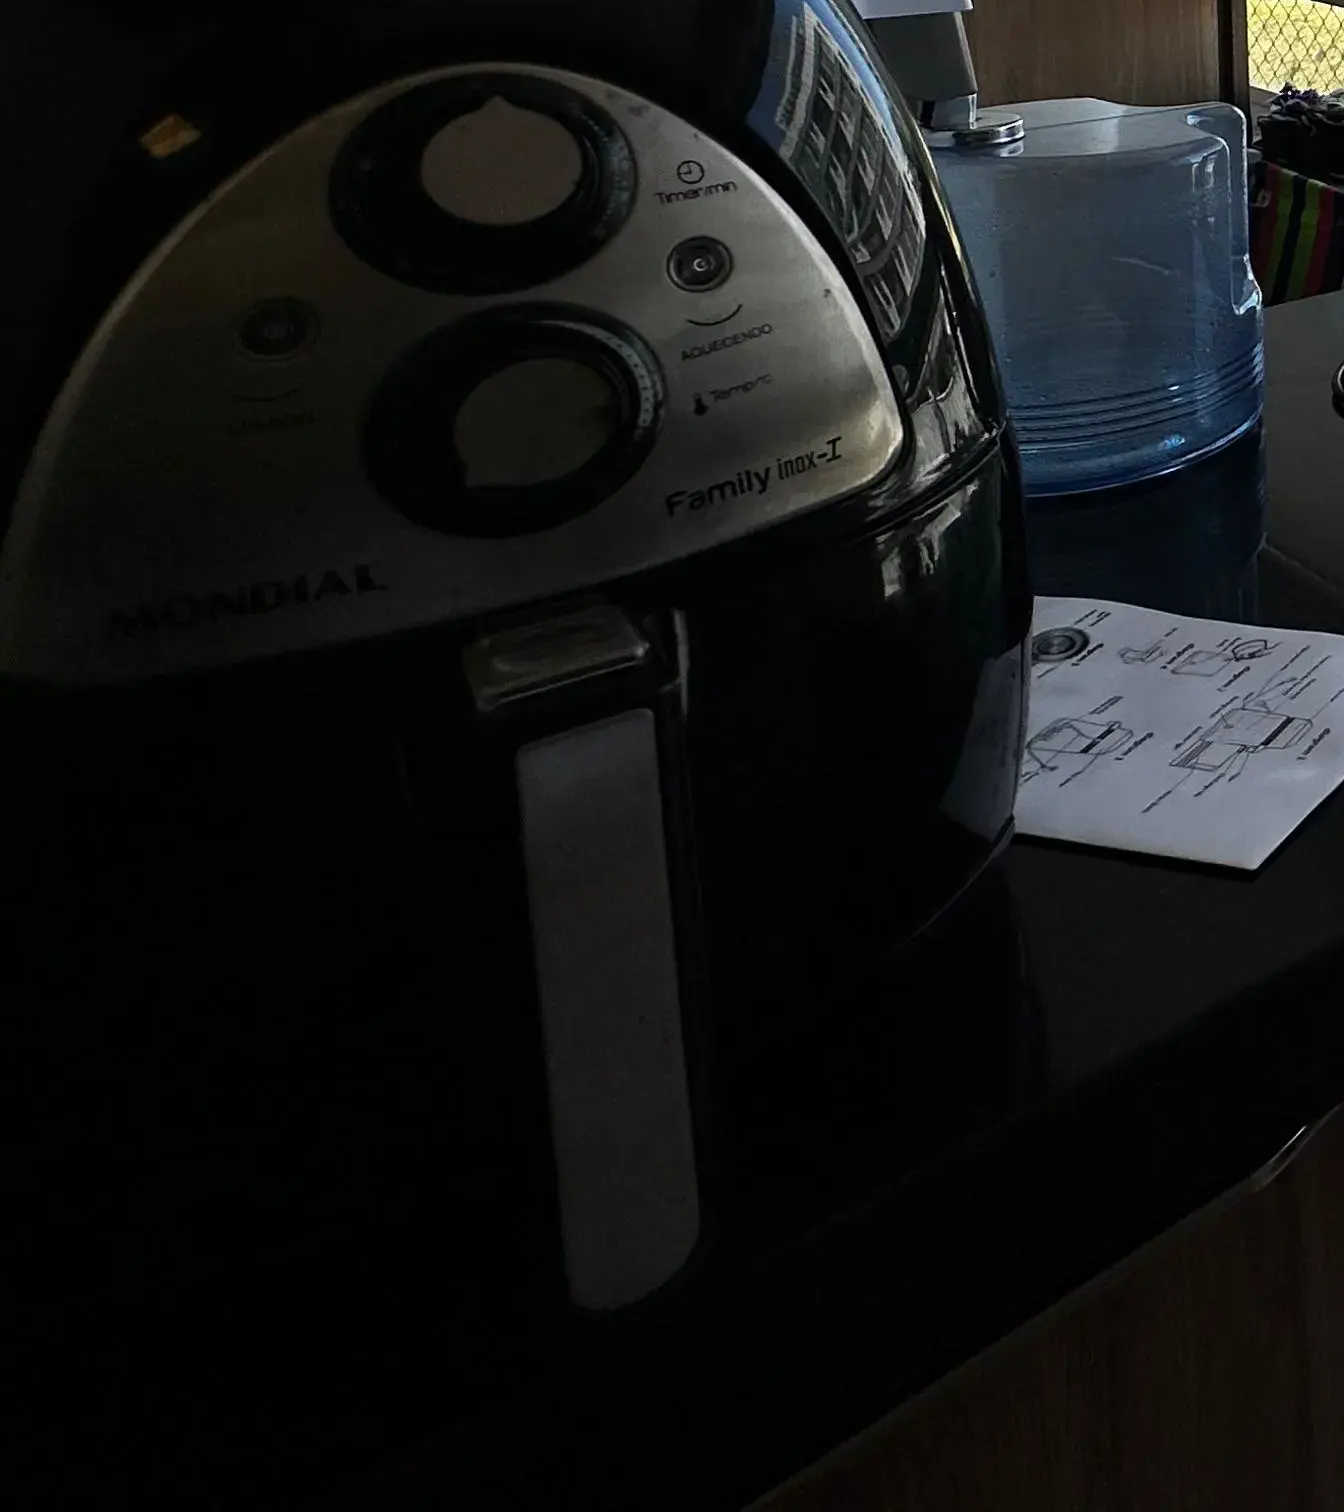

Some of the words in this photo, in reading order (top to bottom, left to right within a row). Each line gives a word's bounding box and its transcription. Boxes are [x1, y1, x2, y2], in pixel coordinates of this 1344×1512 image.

[682, 323, 774, 362] AQUECENDO
[666, 467, 770, 517] Family
[777, 436, 842, 480] inox-I
[108, 565, 388, 639] MONDIAL
